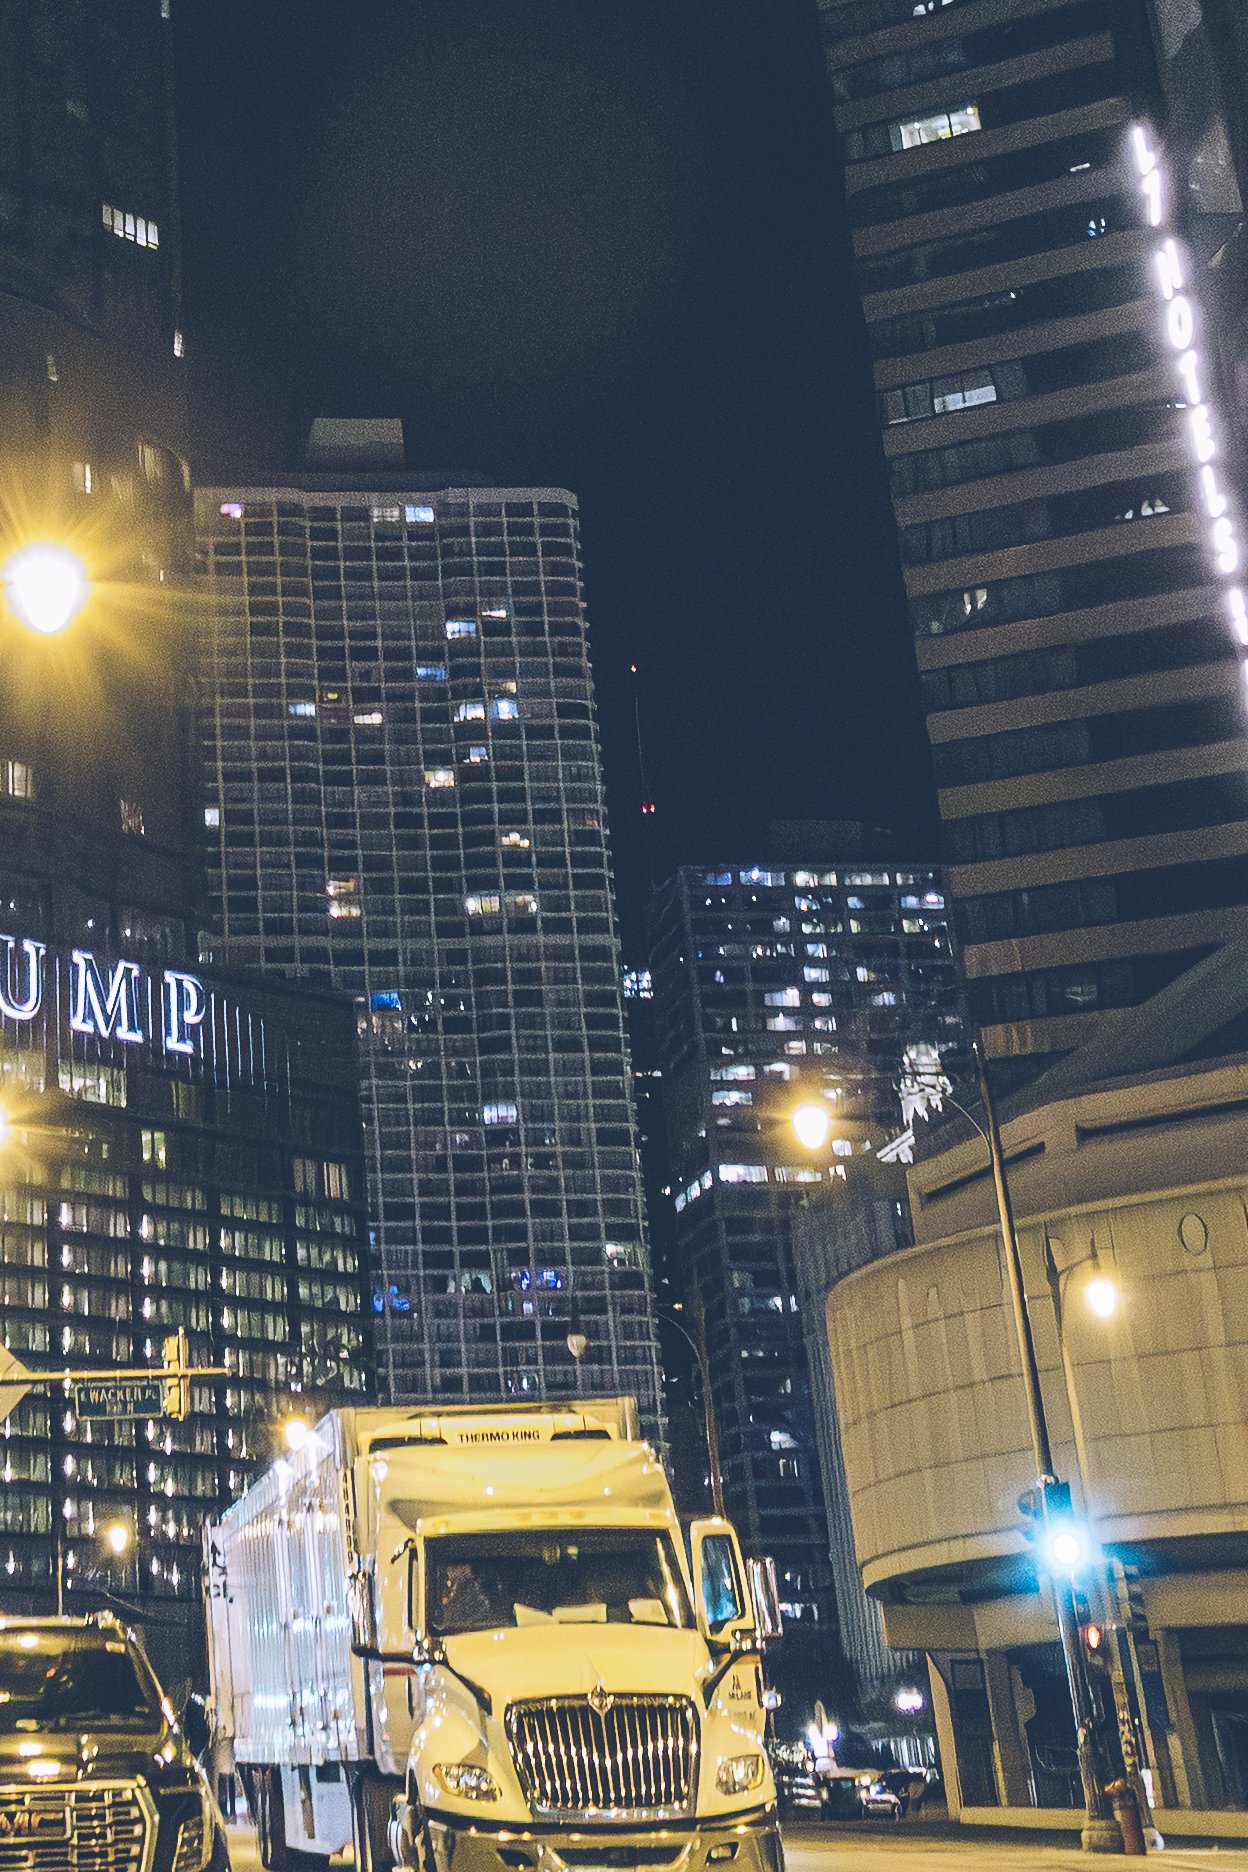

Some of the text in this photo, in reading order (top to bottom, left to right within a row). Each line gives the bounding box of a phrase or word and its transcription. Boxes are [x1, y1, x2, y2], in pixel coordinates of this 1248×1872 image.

[1132, 125, 1238, 574] L7 HOTELS
[89, 1387, 142, 1404] WACKER
[458, 1430, 540, 1444] THERMO KING
